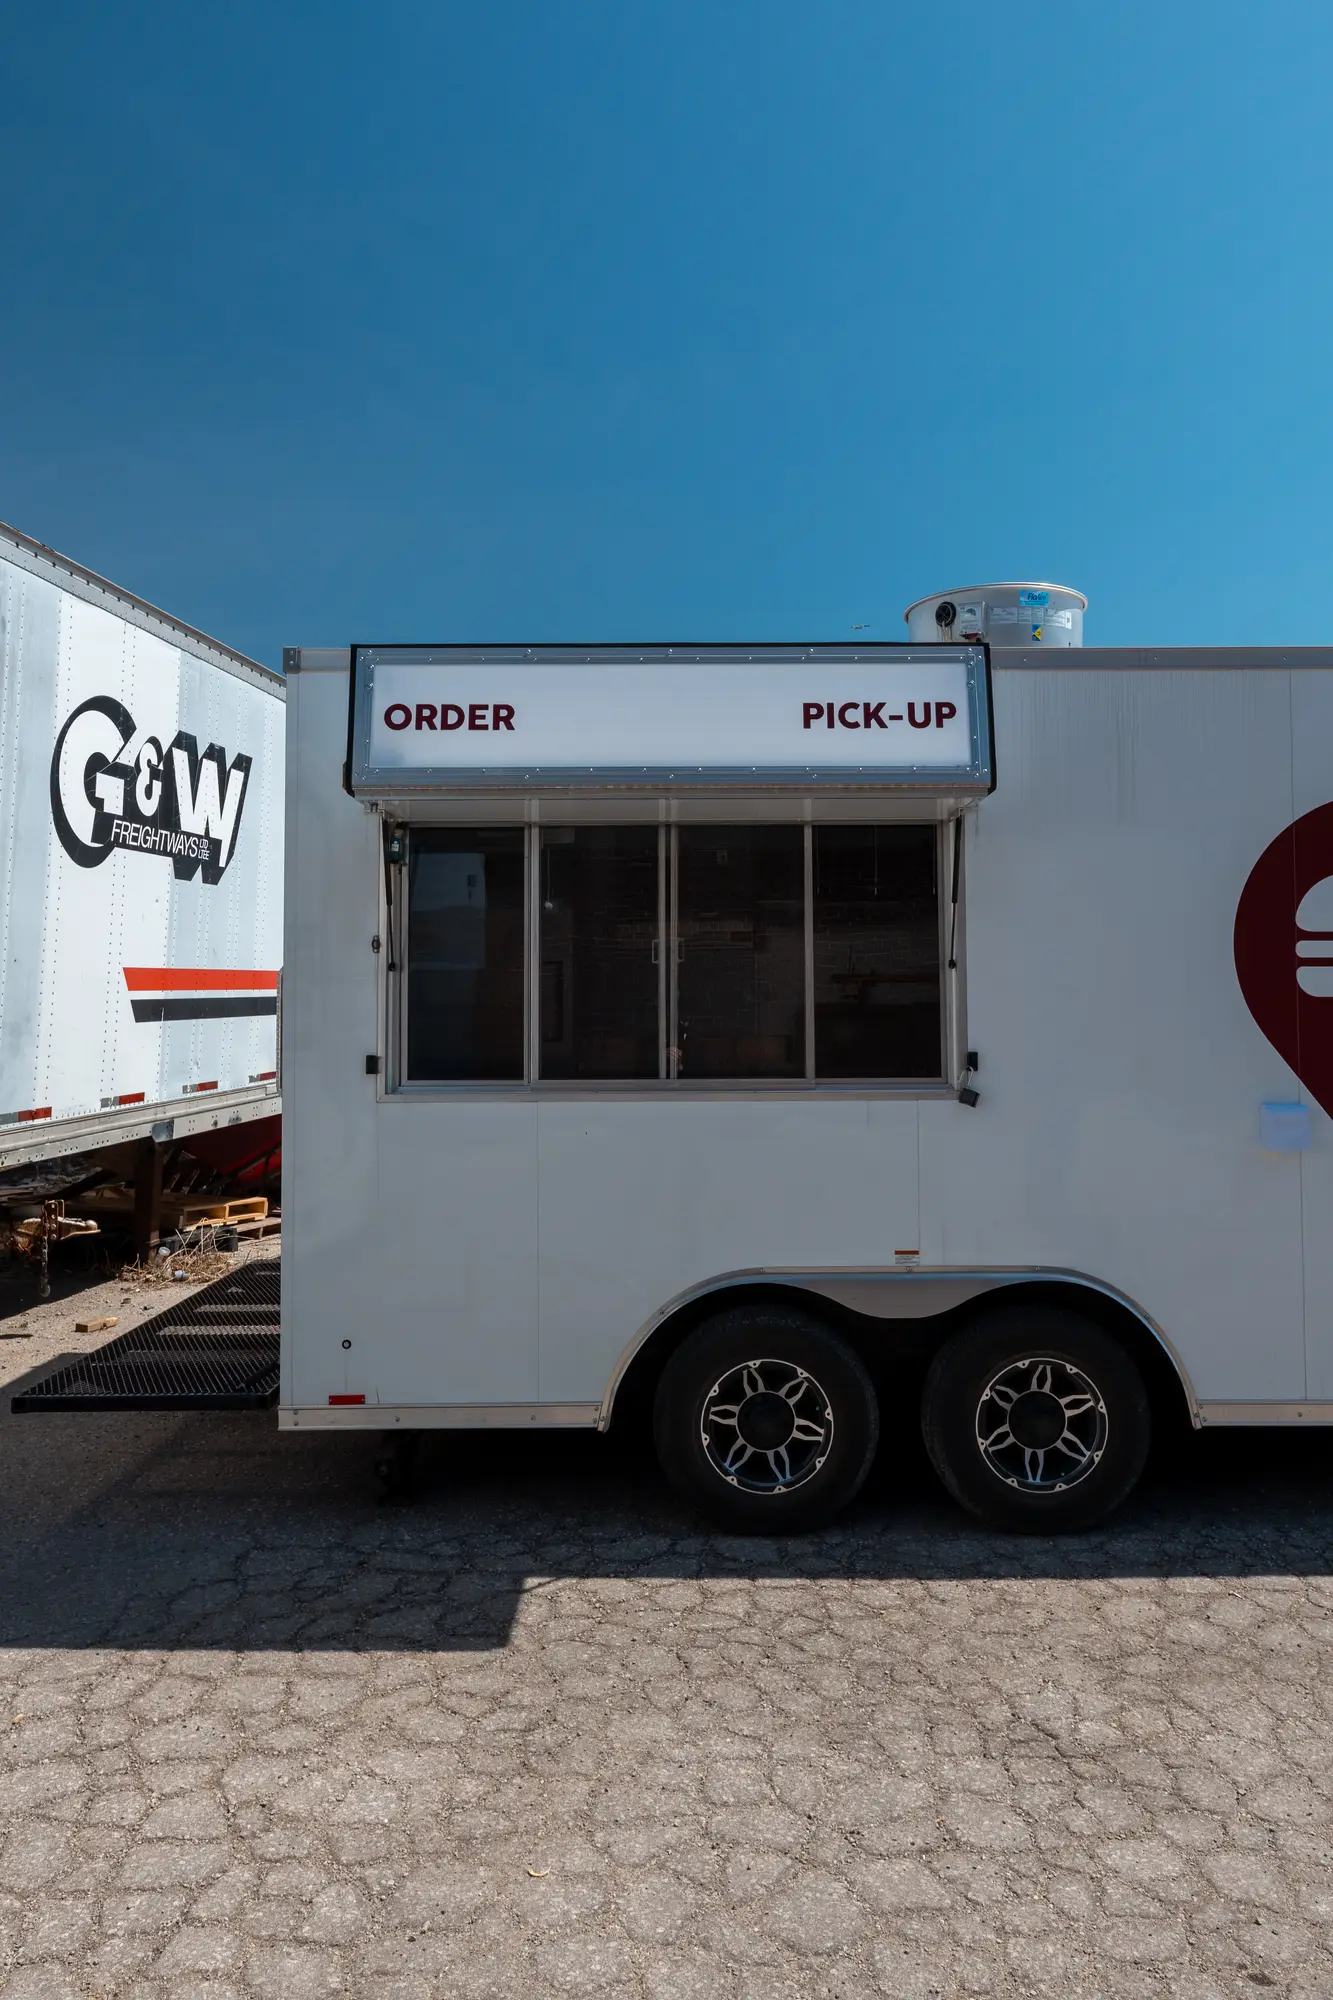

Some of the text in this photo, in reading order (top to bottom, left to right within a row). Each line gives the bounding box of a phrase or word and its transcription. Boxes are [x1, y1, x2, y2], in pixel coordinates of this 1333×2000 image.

[384, 704, 515, 730] ORDER
[803, 702, 957, 730] PICK-UP
[51, 695, 253, 886] G&W
[111, 819, 199, 858] FREIGHTWAYS
